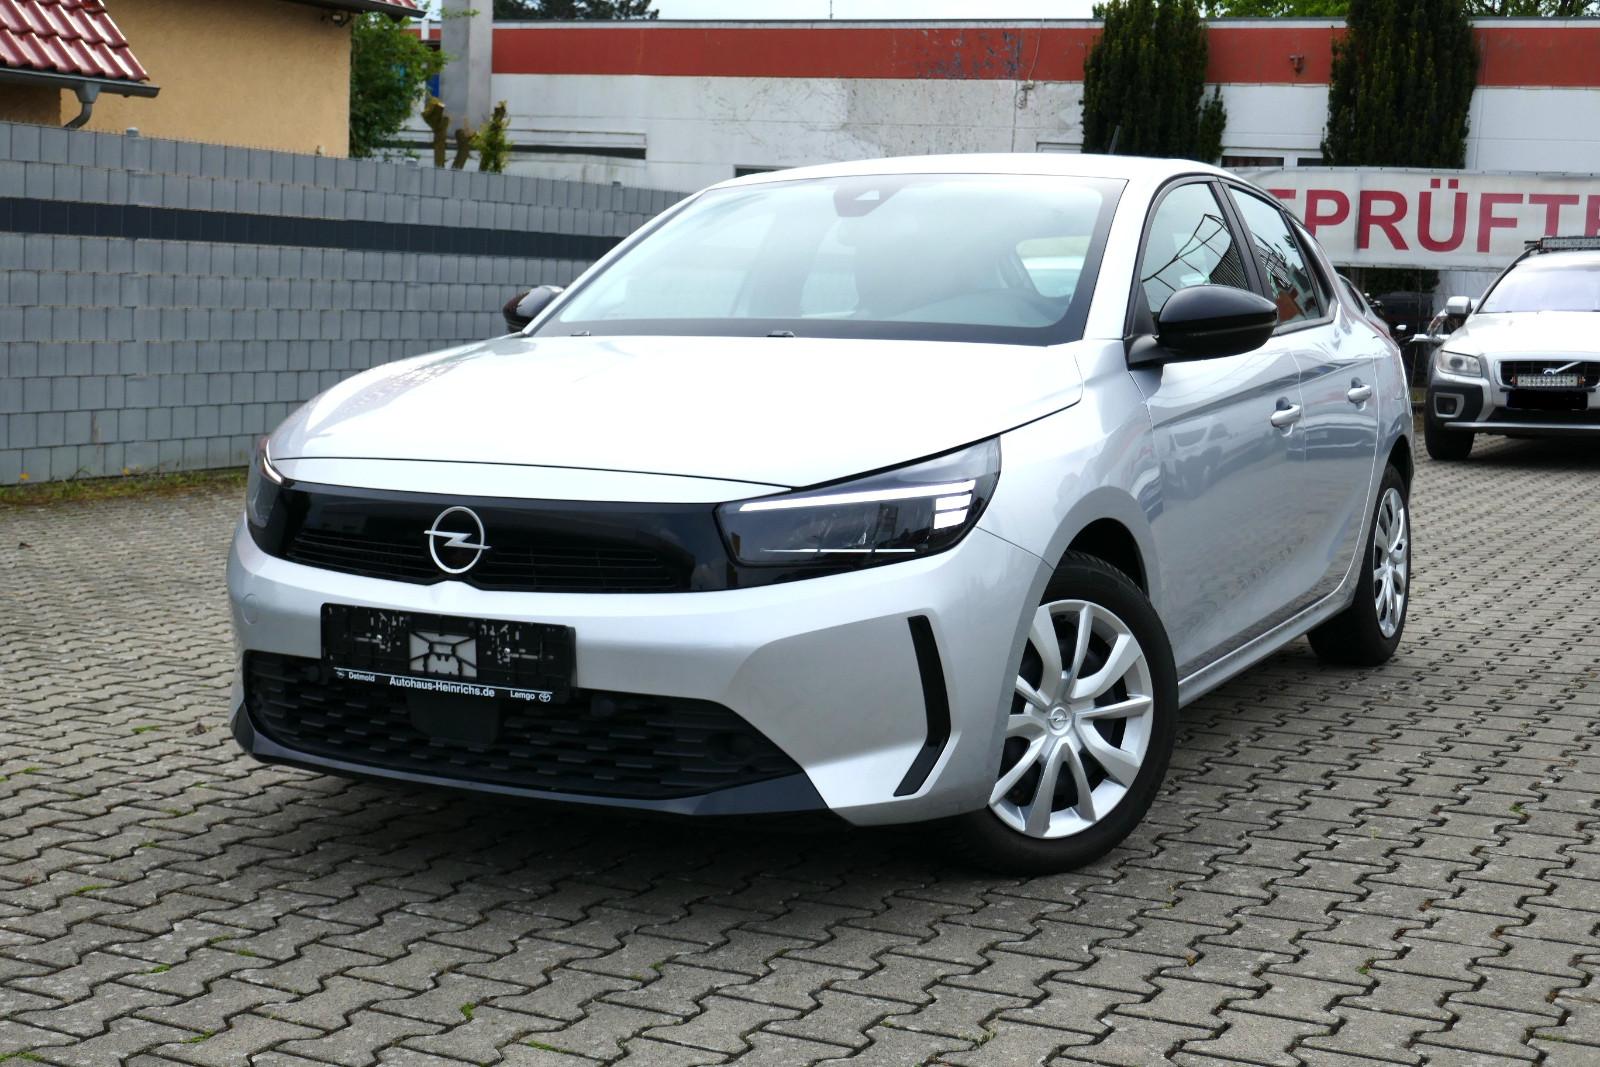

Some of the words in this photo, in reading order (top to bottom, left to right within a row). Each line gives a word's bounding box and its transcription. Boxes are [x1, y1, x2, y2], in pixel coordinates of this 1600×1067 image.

[1266, 178, 1600, 254] PRÜFT
[348, 671, 375, 683] Detmold
[389, 676, 496, 698] Autohaus-Heinrichs.de
[510, 690, 536, 701] Lemgo
